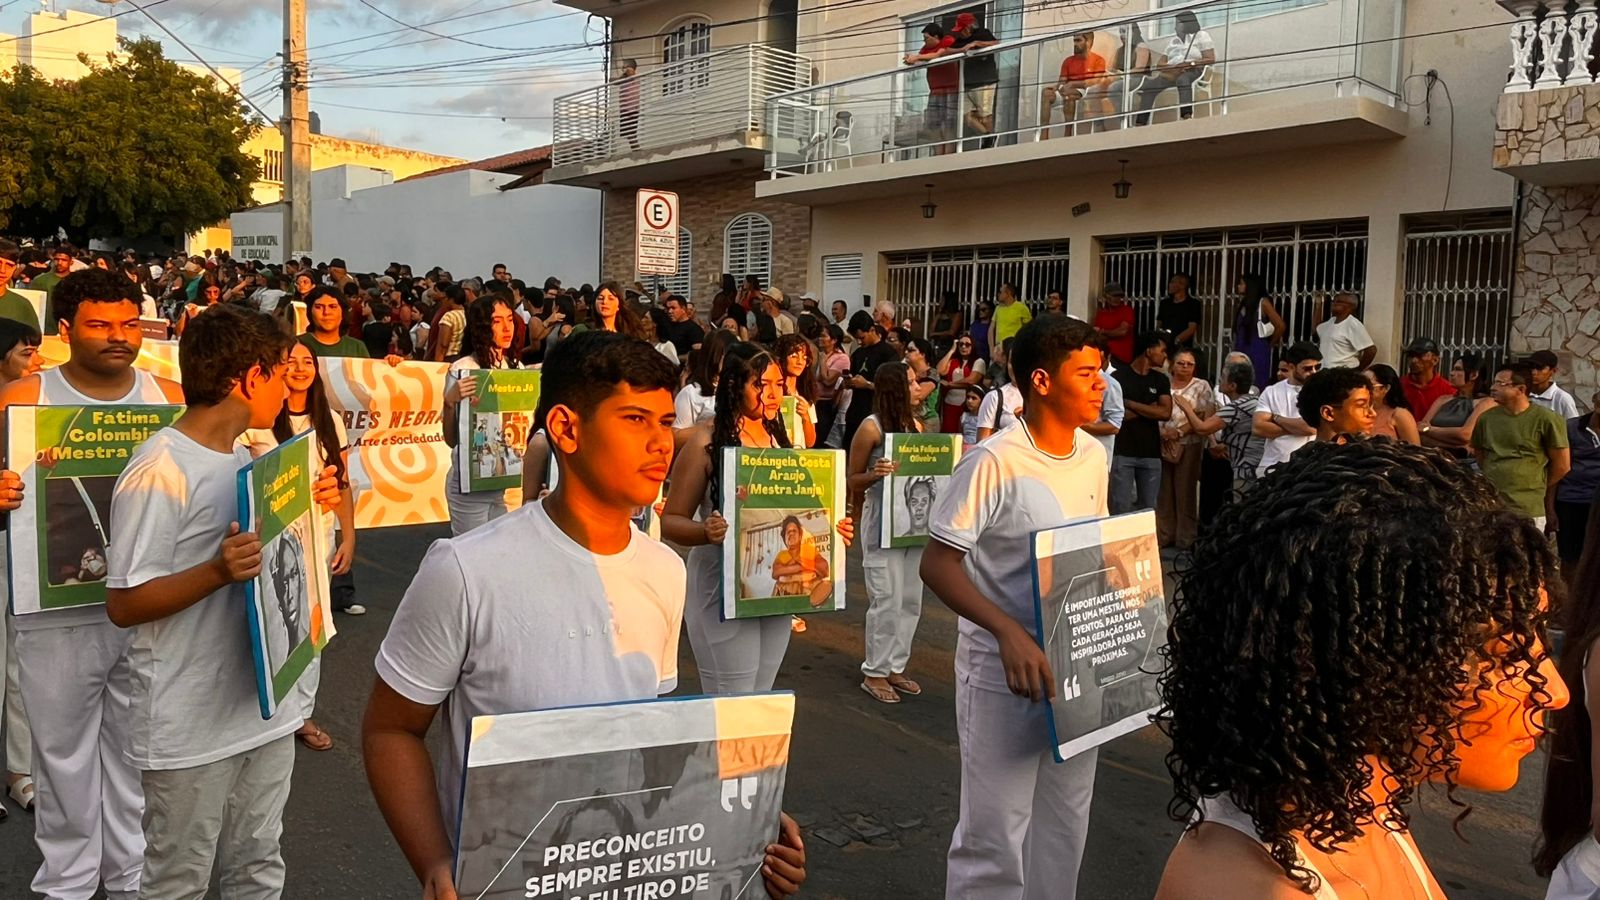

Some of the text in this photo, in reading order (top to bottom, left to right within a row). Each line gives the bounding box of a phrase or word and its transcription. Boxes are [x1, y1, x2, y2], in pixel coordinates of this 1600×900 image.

[654, 204, 663, 221] E
[488, 384, 522, 392] Mestra
[92, 411, 160, 424] Fatima
[354, 438, 379, 447] Arte
[898, 444, 919, 453] Maria
[52, 446, 128, 460] Mestra
[798, 456, 831, 468] Costa
[769, 469, 806, 484] Araujo
[1064, 602, 1070, 614] É
[1070, 592, 1114, 612] IMPORTANTE
[1114, 585, 1140, 600] SEMPRE
[1068, 597, 1140, 625] TER UMA MESTRA NOS
[1105, 613, 1124, 626] PARA
[1124, 609, 1139, 620] QUE
[1071, 620, 1142, 648] CADA GERAÇÃO SEJA
[1070, 629, 1147, 661] INSPIRADORA PARA AS
[1092, 647, 1129, 667] PRÓXIMAS.
[543, 822, 705, 867] PRECONCEITO
[524, 847, 716, 898] SEMPRE EXISTIU,
[624, 878, 676, 900] TIRO
[680, 873, 710, 895] DE
